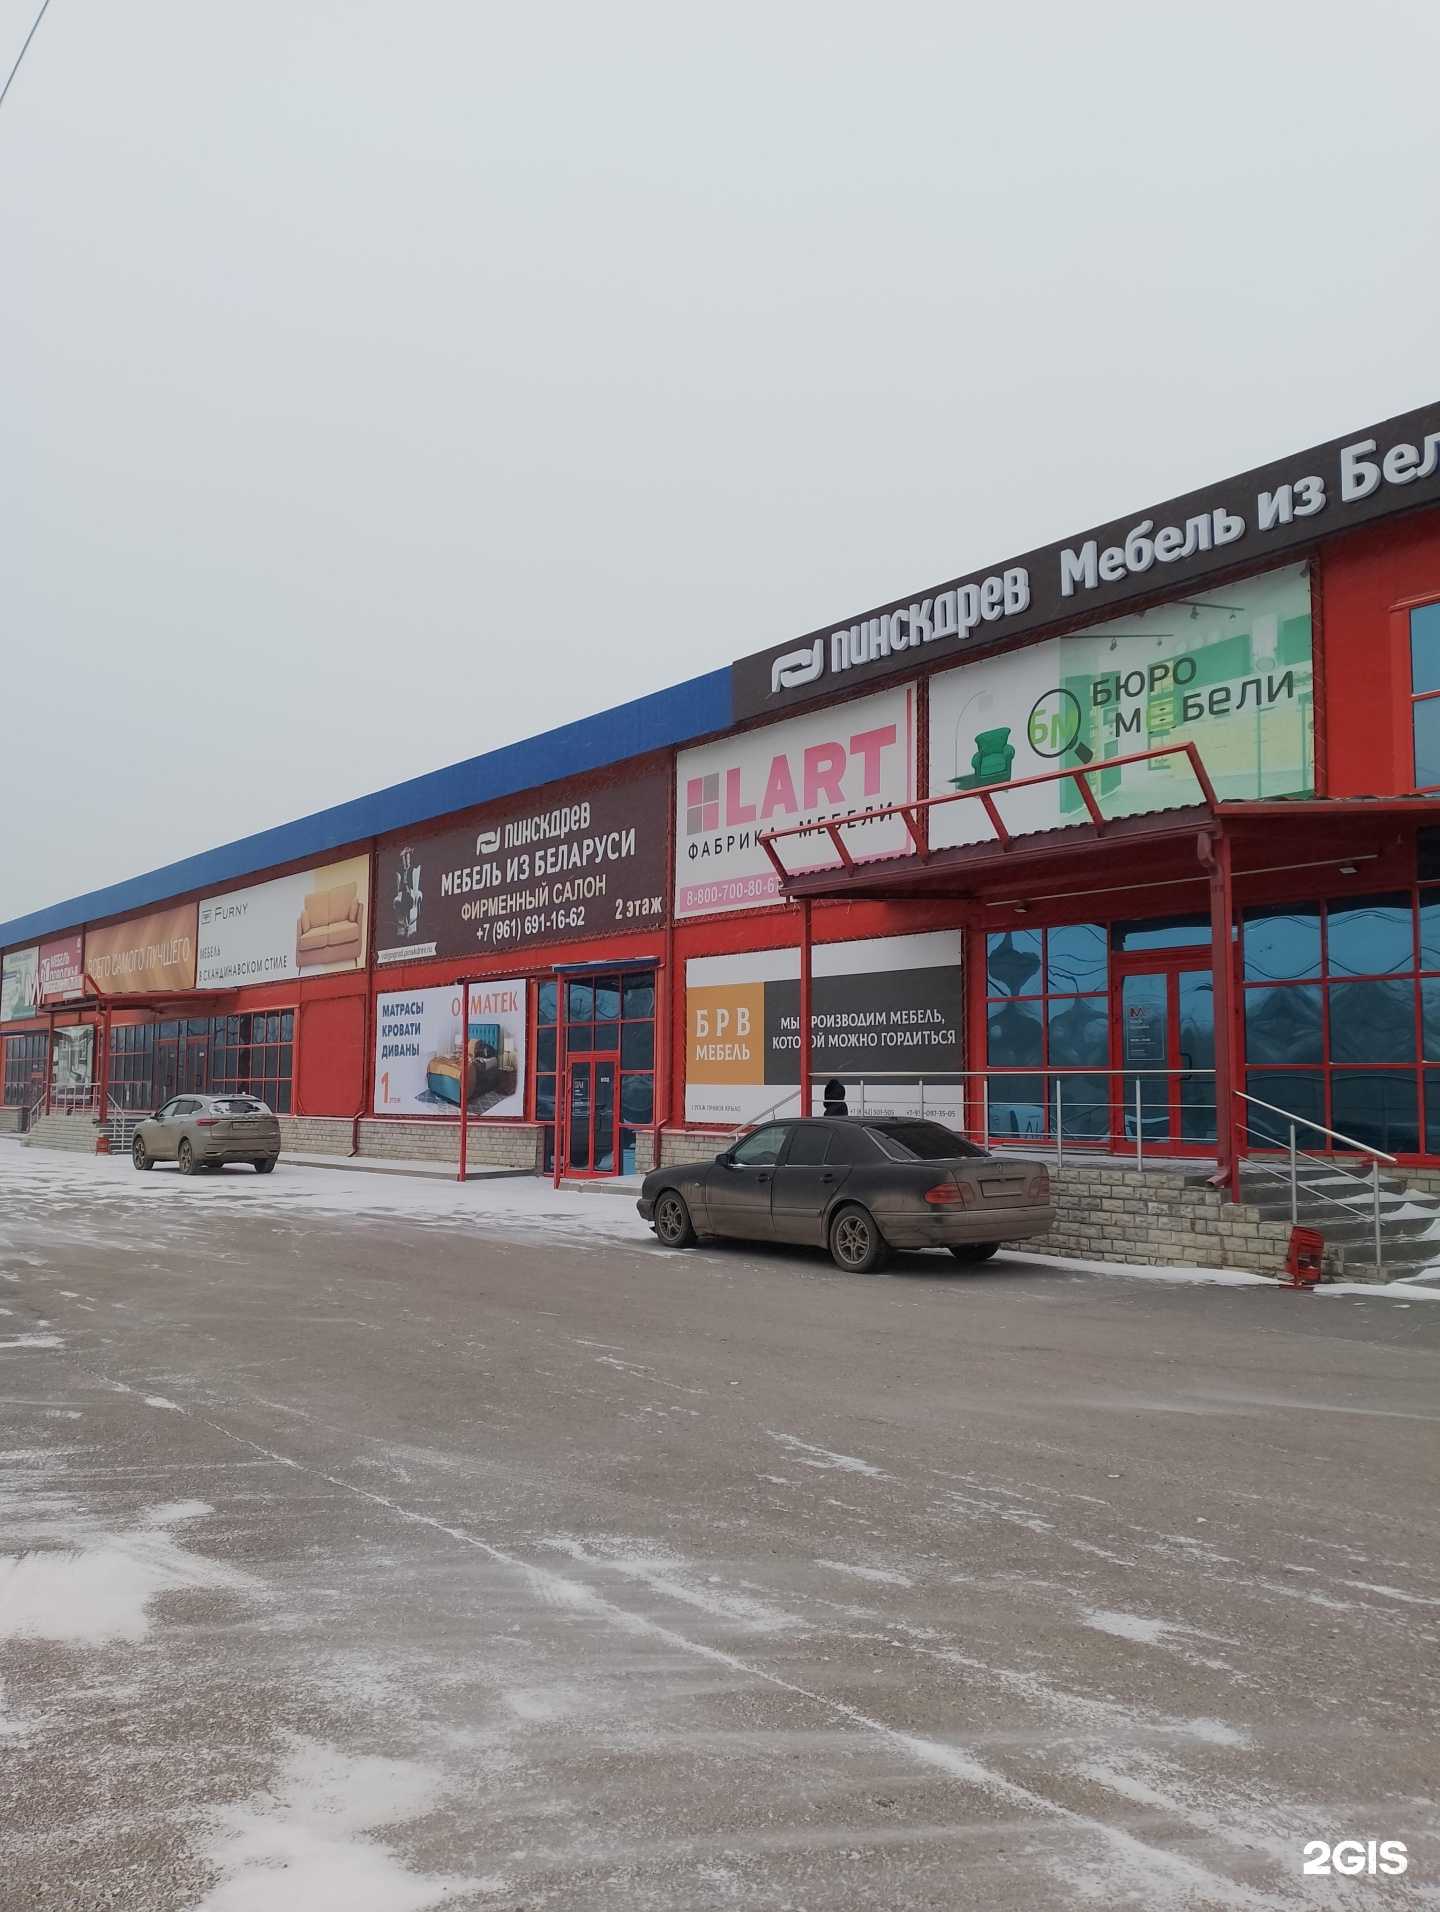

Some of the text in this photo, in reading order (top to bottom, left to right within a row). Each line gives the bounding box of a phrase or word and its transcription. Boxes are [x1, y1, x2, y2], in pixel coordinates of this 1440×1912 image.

[1060, 507, 1246, 597] Мебель
[1257, 475, 1327, 532] из
[1093, 657, 1197, 707] БЮРО
[726, 724, 897, 827] LART
[441, 828, 636, 897] МЕБЕЛЬ ИЗ БЕЛАРУСИ
[461, 874, 607, 921] ФИРМЕННЫЙ САЛОН
[615, 896, 663, 920] 2 этаж
[214, 903, 248, 921] FURNY
[476, 906, 585, 945] +7 (961) 691-16-62
[204, 960, 263, 981] СКАНДИНАВСКОМ
[264, 955, 288, 971] СТИЛЕ
[382, 1001, 424, 1018] МАТРАСЫ
[452, 991, 519, 1016] ОМАТЕК
[382, 1022, 421, 1037] КРОВАТИ
[780, 1008, 945, 1030] МЫ РОИЗВОДИМ МЕБЕЛЬ,
[828, 1032, 878, 1048] МОЖНО
[881, 1029, 956, 1047] ГОРДИТЬСЯ
[381, 1043, 420, 1060] ДИВАНЫ
[696, 1043, 751, 1062] МЕБЕЛЬ
[381, 1072, 389, 1104] 1
